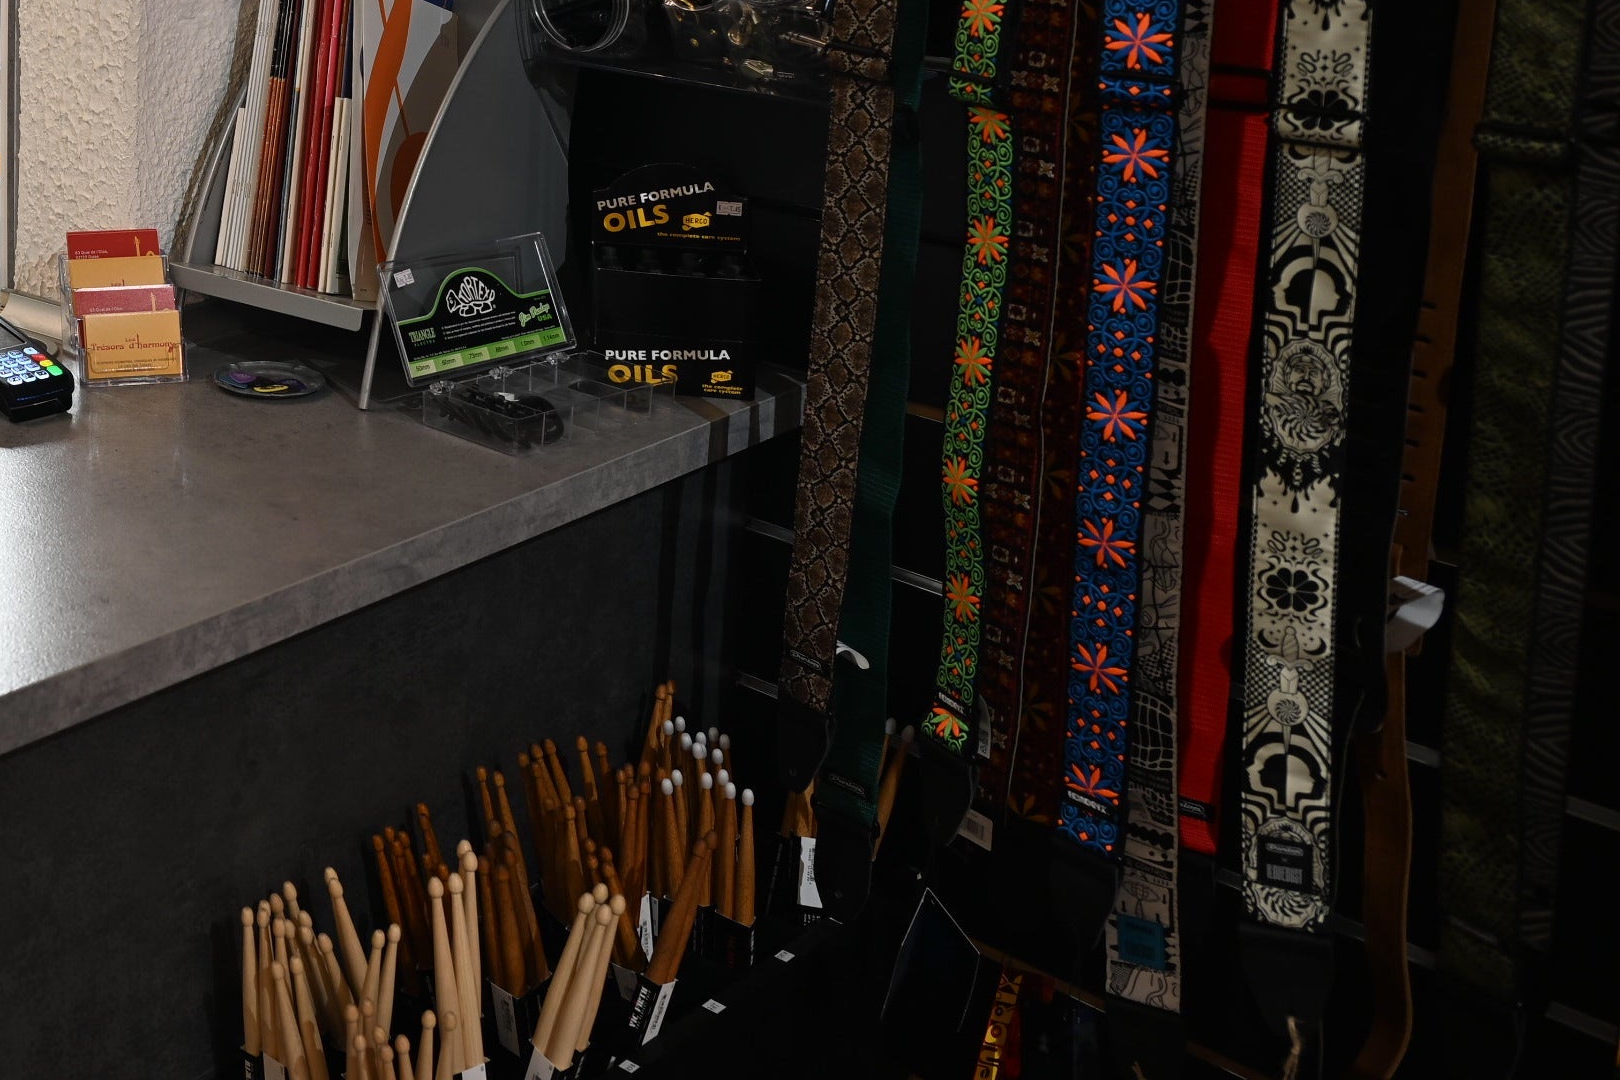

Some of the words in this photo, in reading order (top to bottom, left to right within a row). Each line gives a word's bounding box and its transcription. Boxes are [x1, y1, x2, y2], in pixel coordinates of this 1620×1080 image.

[596, 194, 637, 211] PURE
[639, 181, 716, 204] FORMULA
[602, 203, 671, 233] OILS
[685, 217, 708, 225] HERCO
[670, 232, 700, 240] complete
[537, 313, 553, 322] USA
[408, 327, 437, 343] TRIANGLE
[90, 342, 125, 352] Trésors
[604, 349, 647, 361] PURE
[651, 349, 731, 361] FORMULA
[607, 363, 680, 385] OILS
[634, 986, 649, 1013] FIRTH
